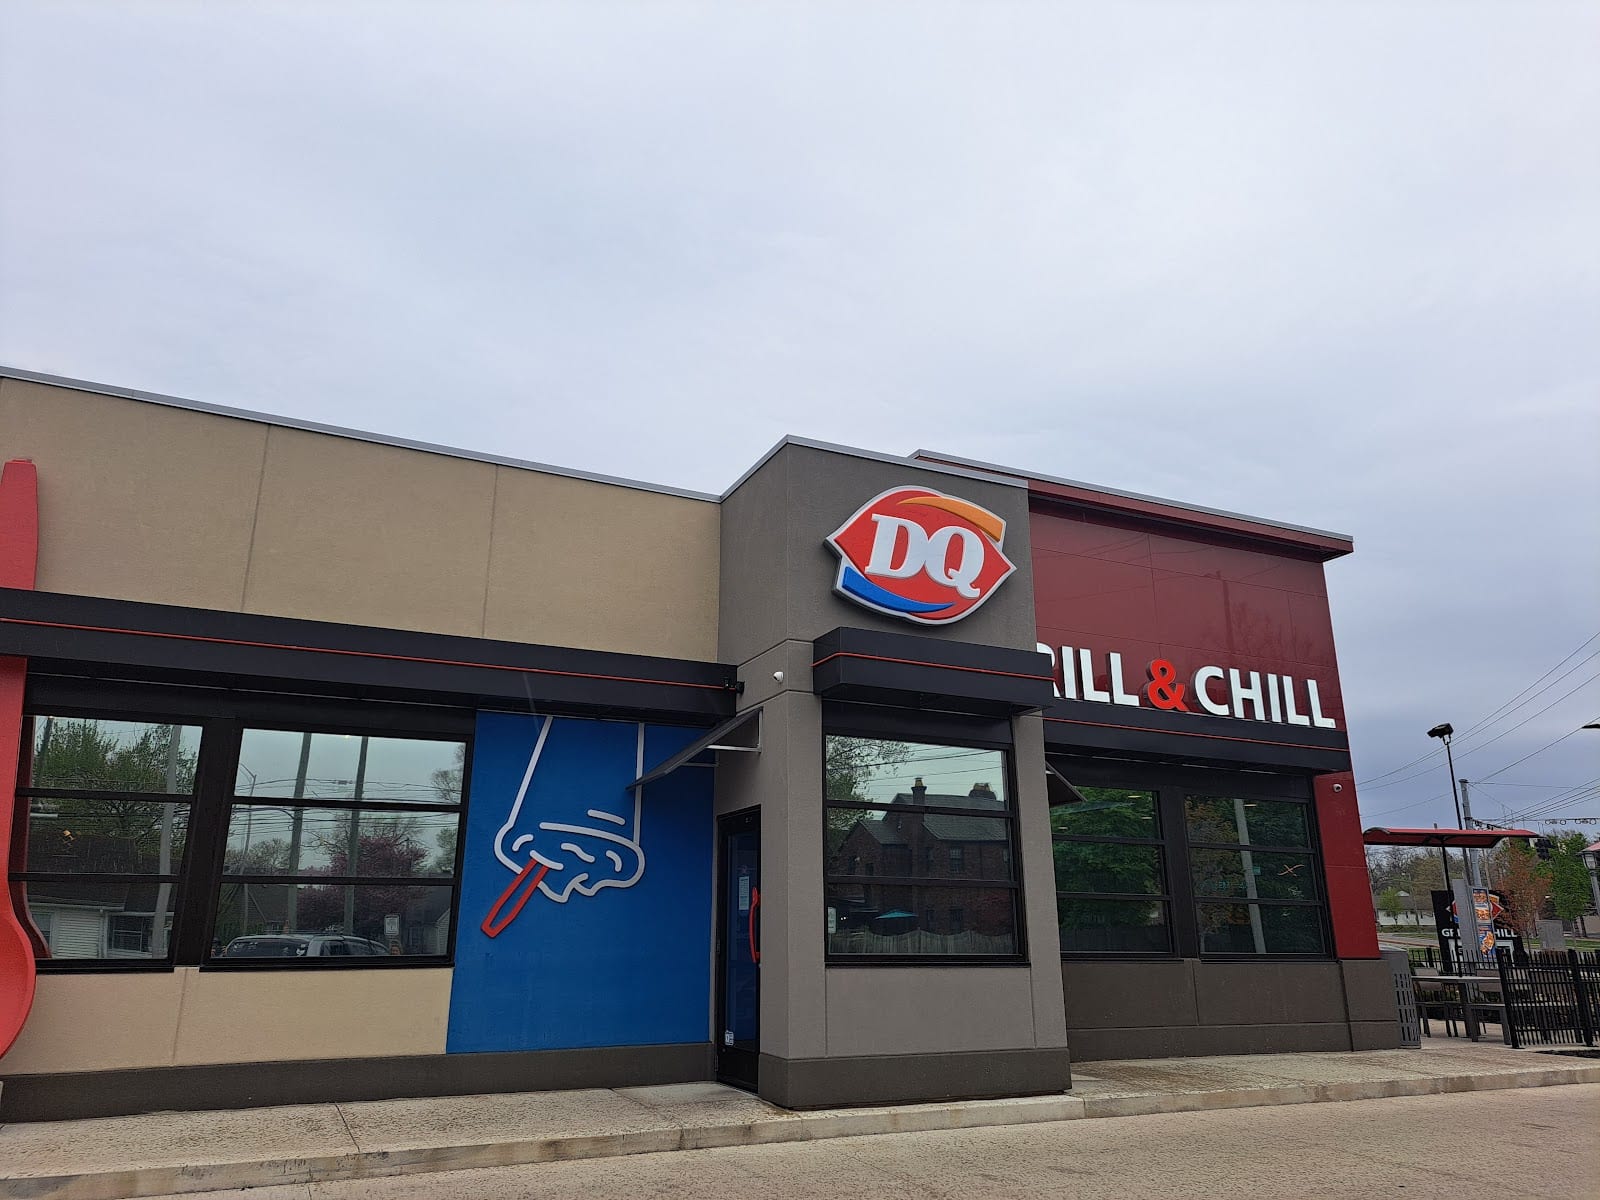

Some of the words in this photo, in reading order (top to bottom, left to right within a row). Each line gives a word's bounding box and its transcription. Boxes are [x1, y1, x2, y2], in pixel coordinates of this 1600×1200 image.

[865, 513, 984, 599] DQ
[1147, 659, 1190, 712] &
[1194, 665, 1336, 728] CHILL
